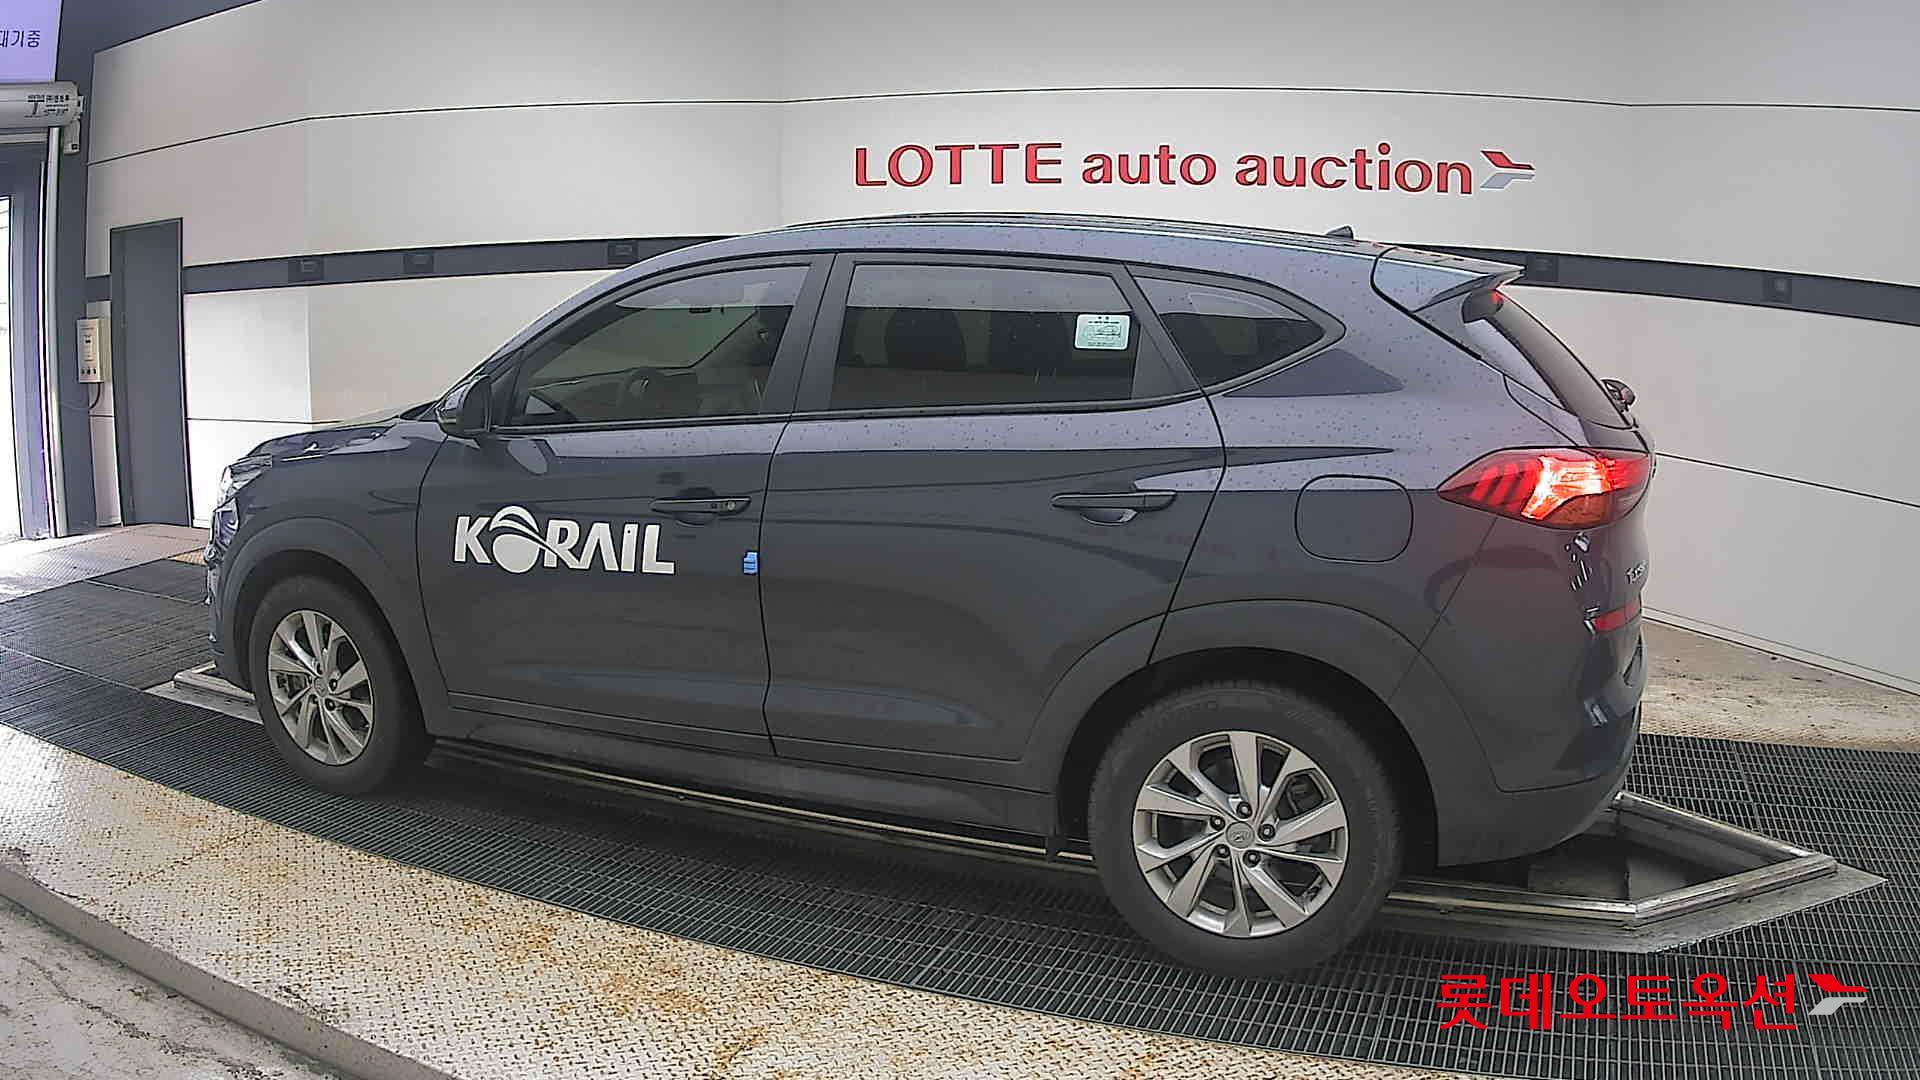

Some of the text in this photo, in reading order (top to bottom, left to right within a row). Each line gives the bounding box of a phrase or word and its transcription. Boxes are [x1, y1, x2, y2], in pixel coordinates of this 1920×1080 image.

[854, 142, 1473, 195] LOTTE auto auction
[453, 504, 677, 575] KORAIL
